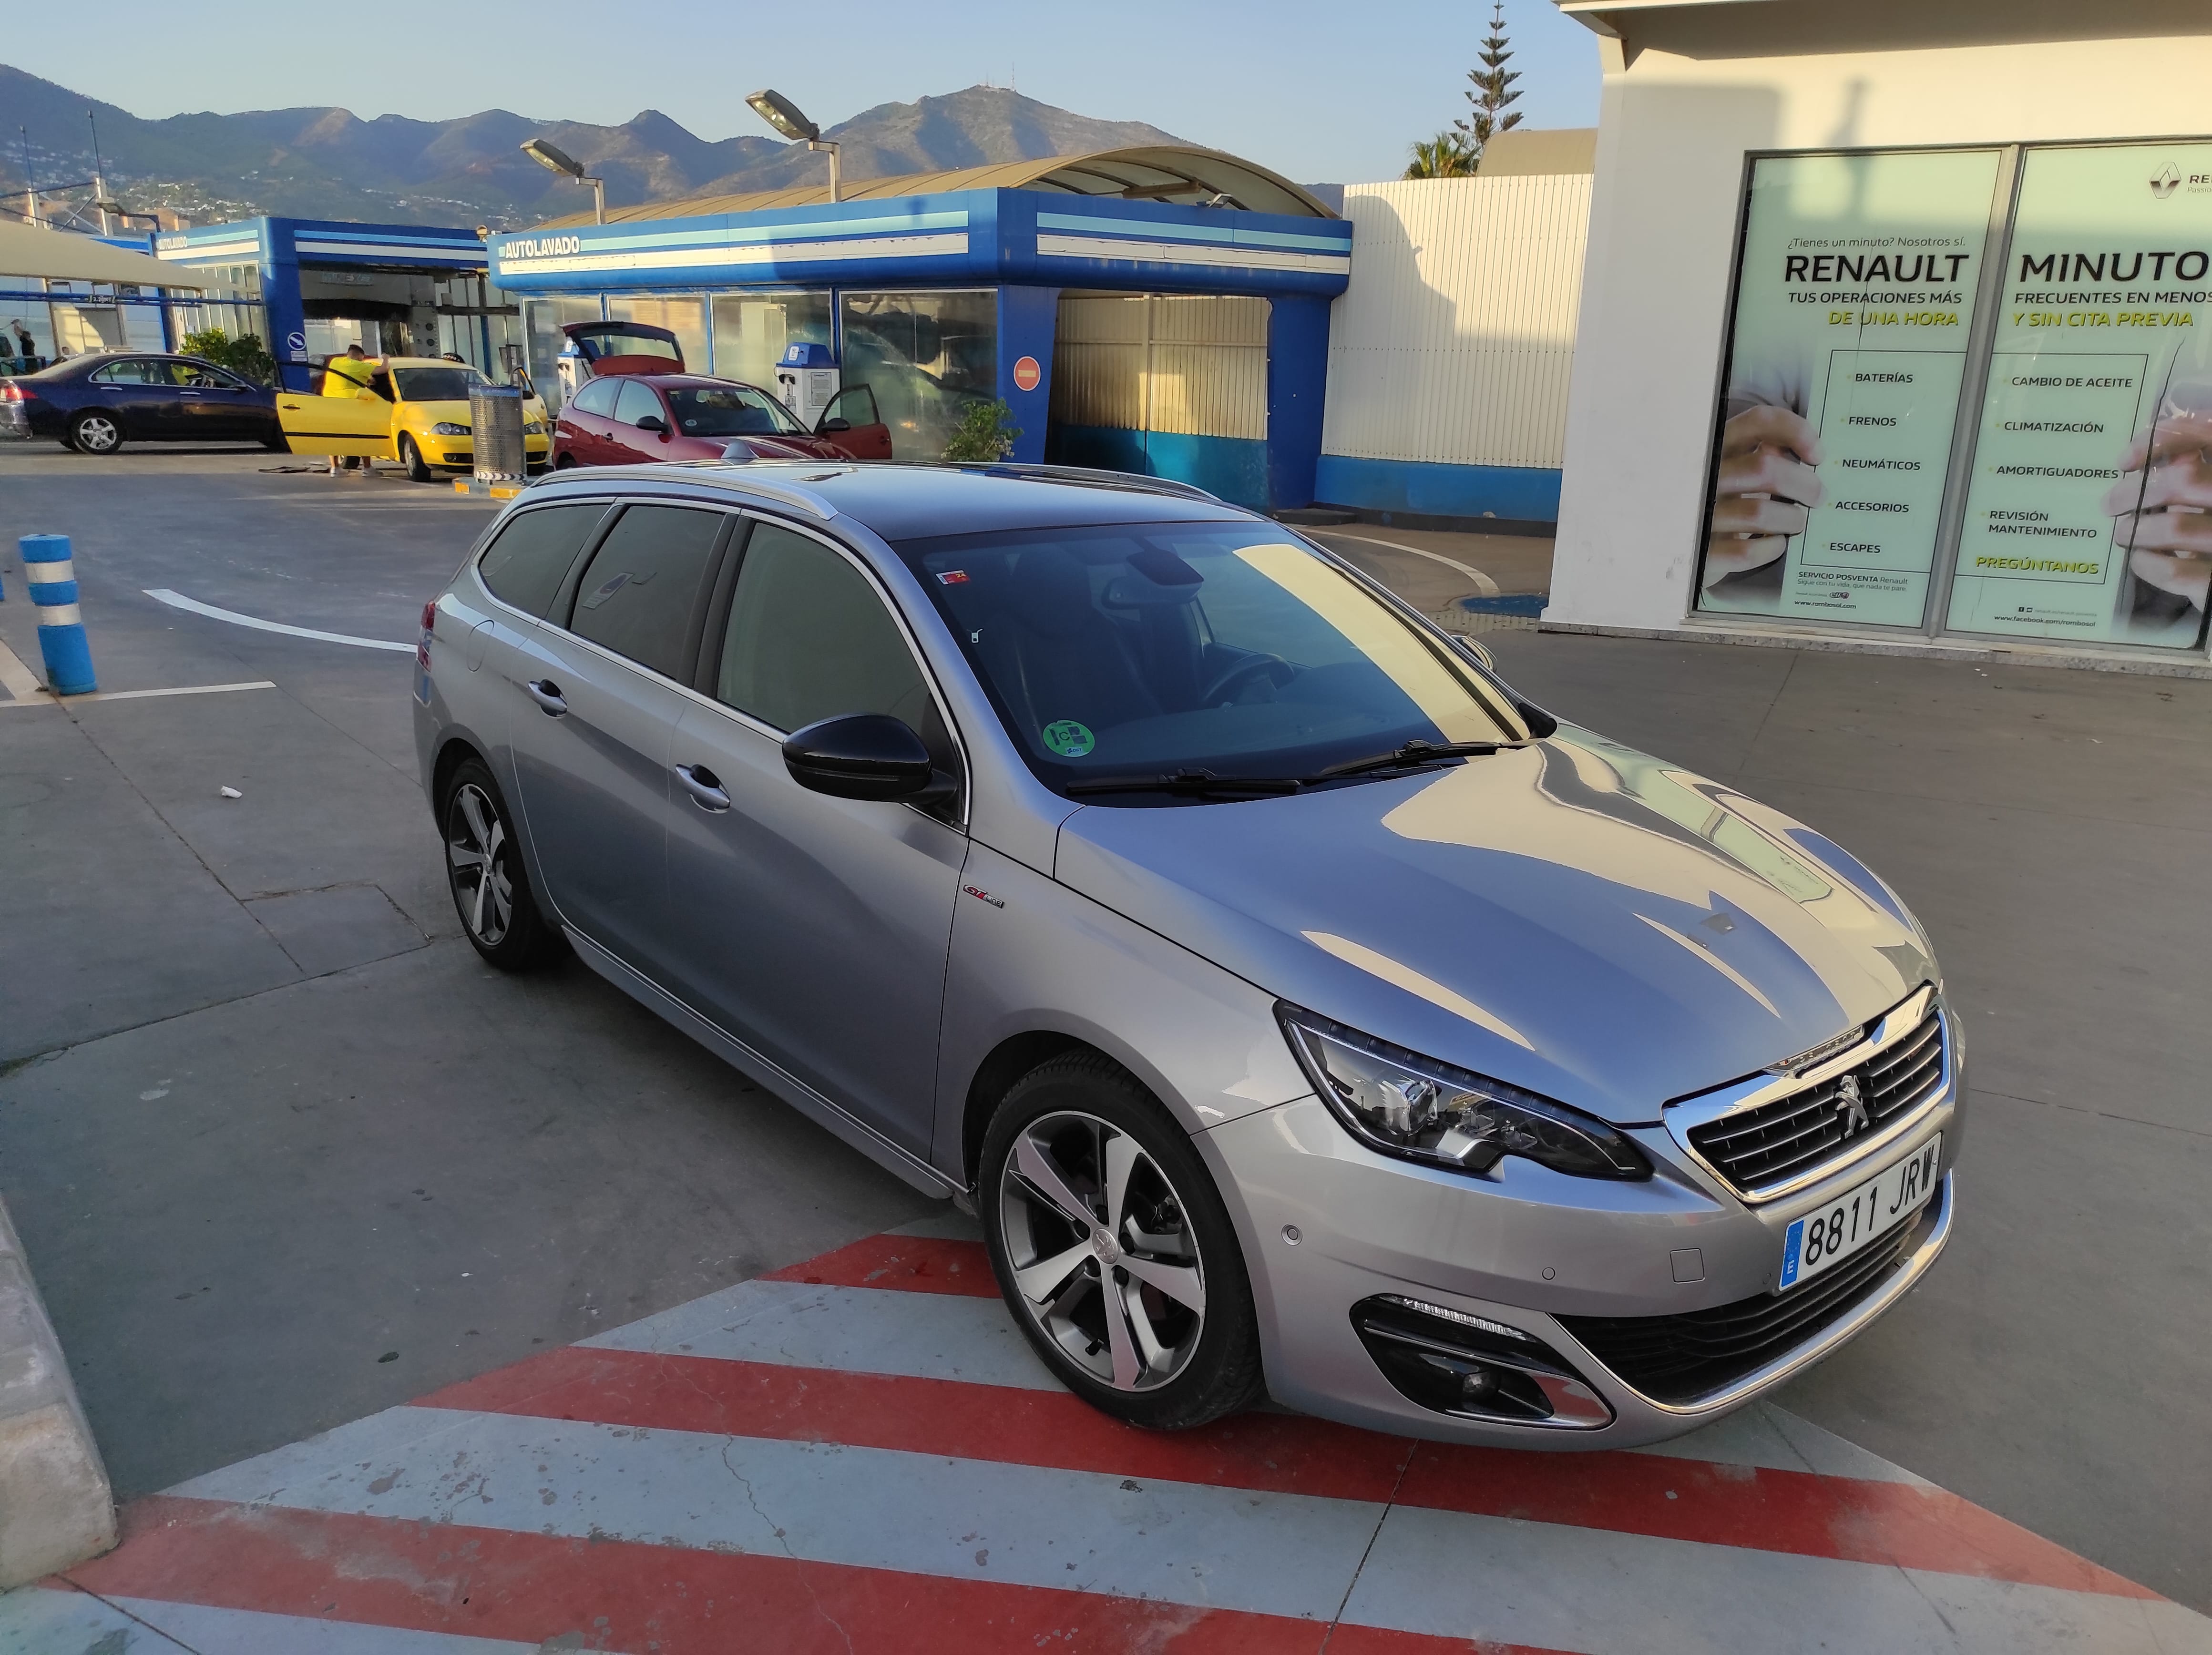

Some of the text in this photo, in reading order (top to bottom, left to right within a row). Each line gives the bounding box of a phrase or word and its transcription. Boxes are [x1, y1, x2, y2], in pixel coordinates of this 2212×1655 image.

[505, 236, 580, 258] AUTOLAVADO
[1788, 238, 1828, 249] ¿Tienes
[1849, 237, 1895, 247] minuto?
[1898, 237, 1950, 246] Nosotros
[1954, 236, 1966, 246] sí.
[1785, 251, 2209, 282] RENAULT MINUTO
[1788, 292, 1816, 303] TUS
[1821, 292, 1925, 304] OPERACIONES
[1930, 289, 1962, 304] MÁS
[2015, 292, 2121, 304] FRECUENTES
[2127, 292, 2149, 303] EN
[1829, 311, 2193, 327] DE UNA HORA Y SIN CITA PREVIA
[1855, 372, 1913, 383] BATERÍAS
[2012, 377, 2133, 388] CAMBIO DE ACEITE
[1849, 417, 1896, 426] FRENOS
[2004, 421, 2104, 433] CLIMATIZACIÓN
[1842, 459, 1921, 470] NEUMÁTICOS
[1997, 466, 2119, 479] AMORTIGUADORES
[1835, 501, 1909, 512] ACCESORIOS
[1990, 511, 2048, 521] REVISIÓN
[1989, 524, 2097, 538] MANTENIMIENTO
[1830, 542, 1881, 553] ESCAPES
[1976, 556, 2099, 574] PREGÚNTANOS
[1799, 572, 1834, 580] SERVICIO
[1836, 574, 1878, 582] POSVENTA
[1794, 600, 1856, 609] www.rombosol.com
[1994, 615, 2096, 627] www.facebook.com/rombosol
[1805, 1144, 1935, 1266] 8811 JRW
